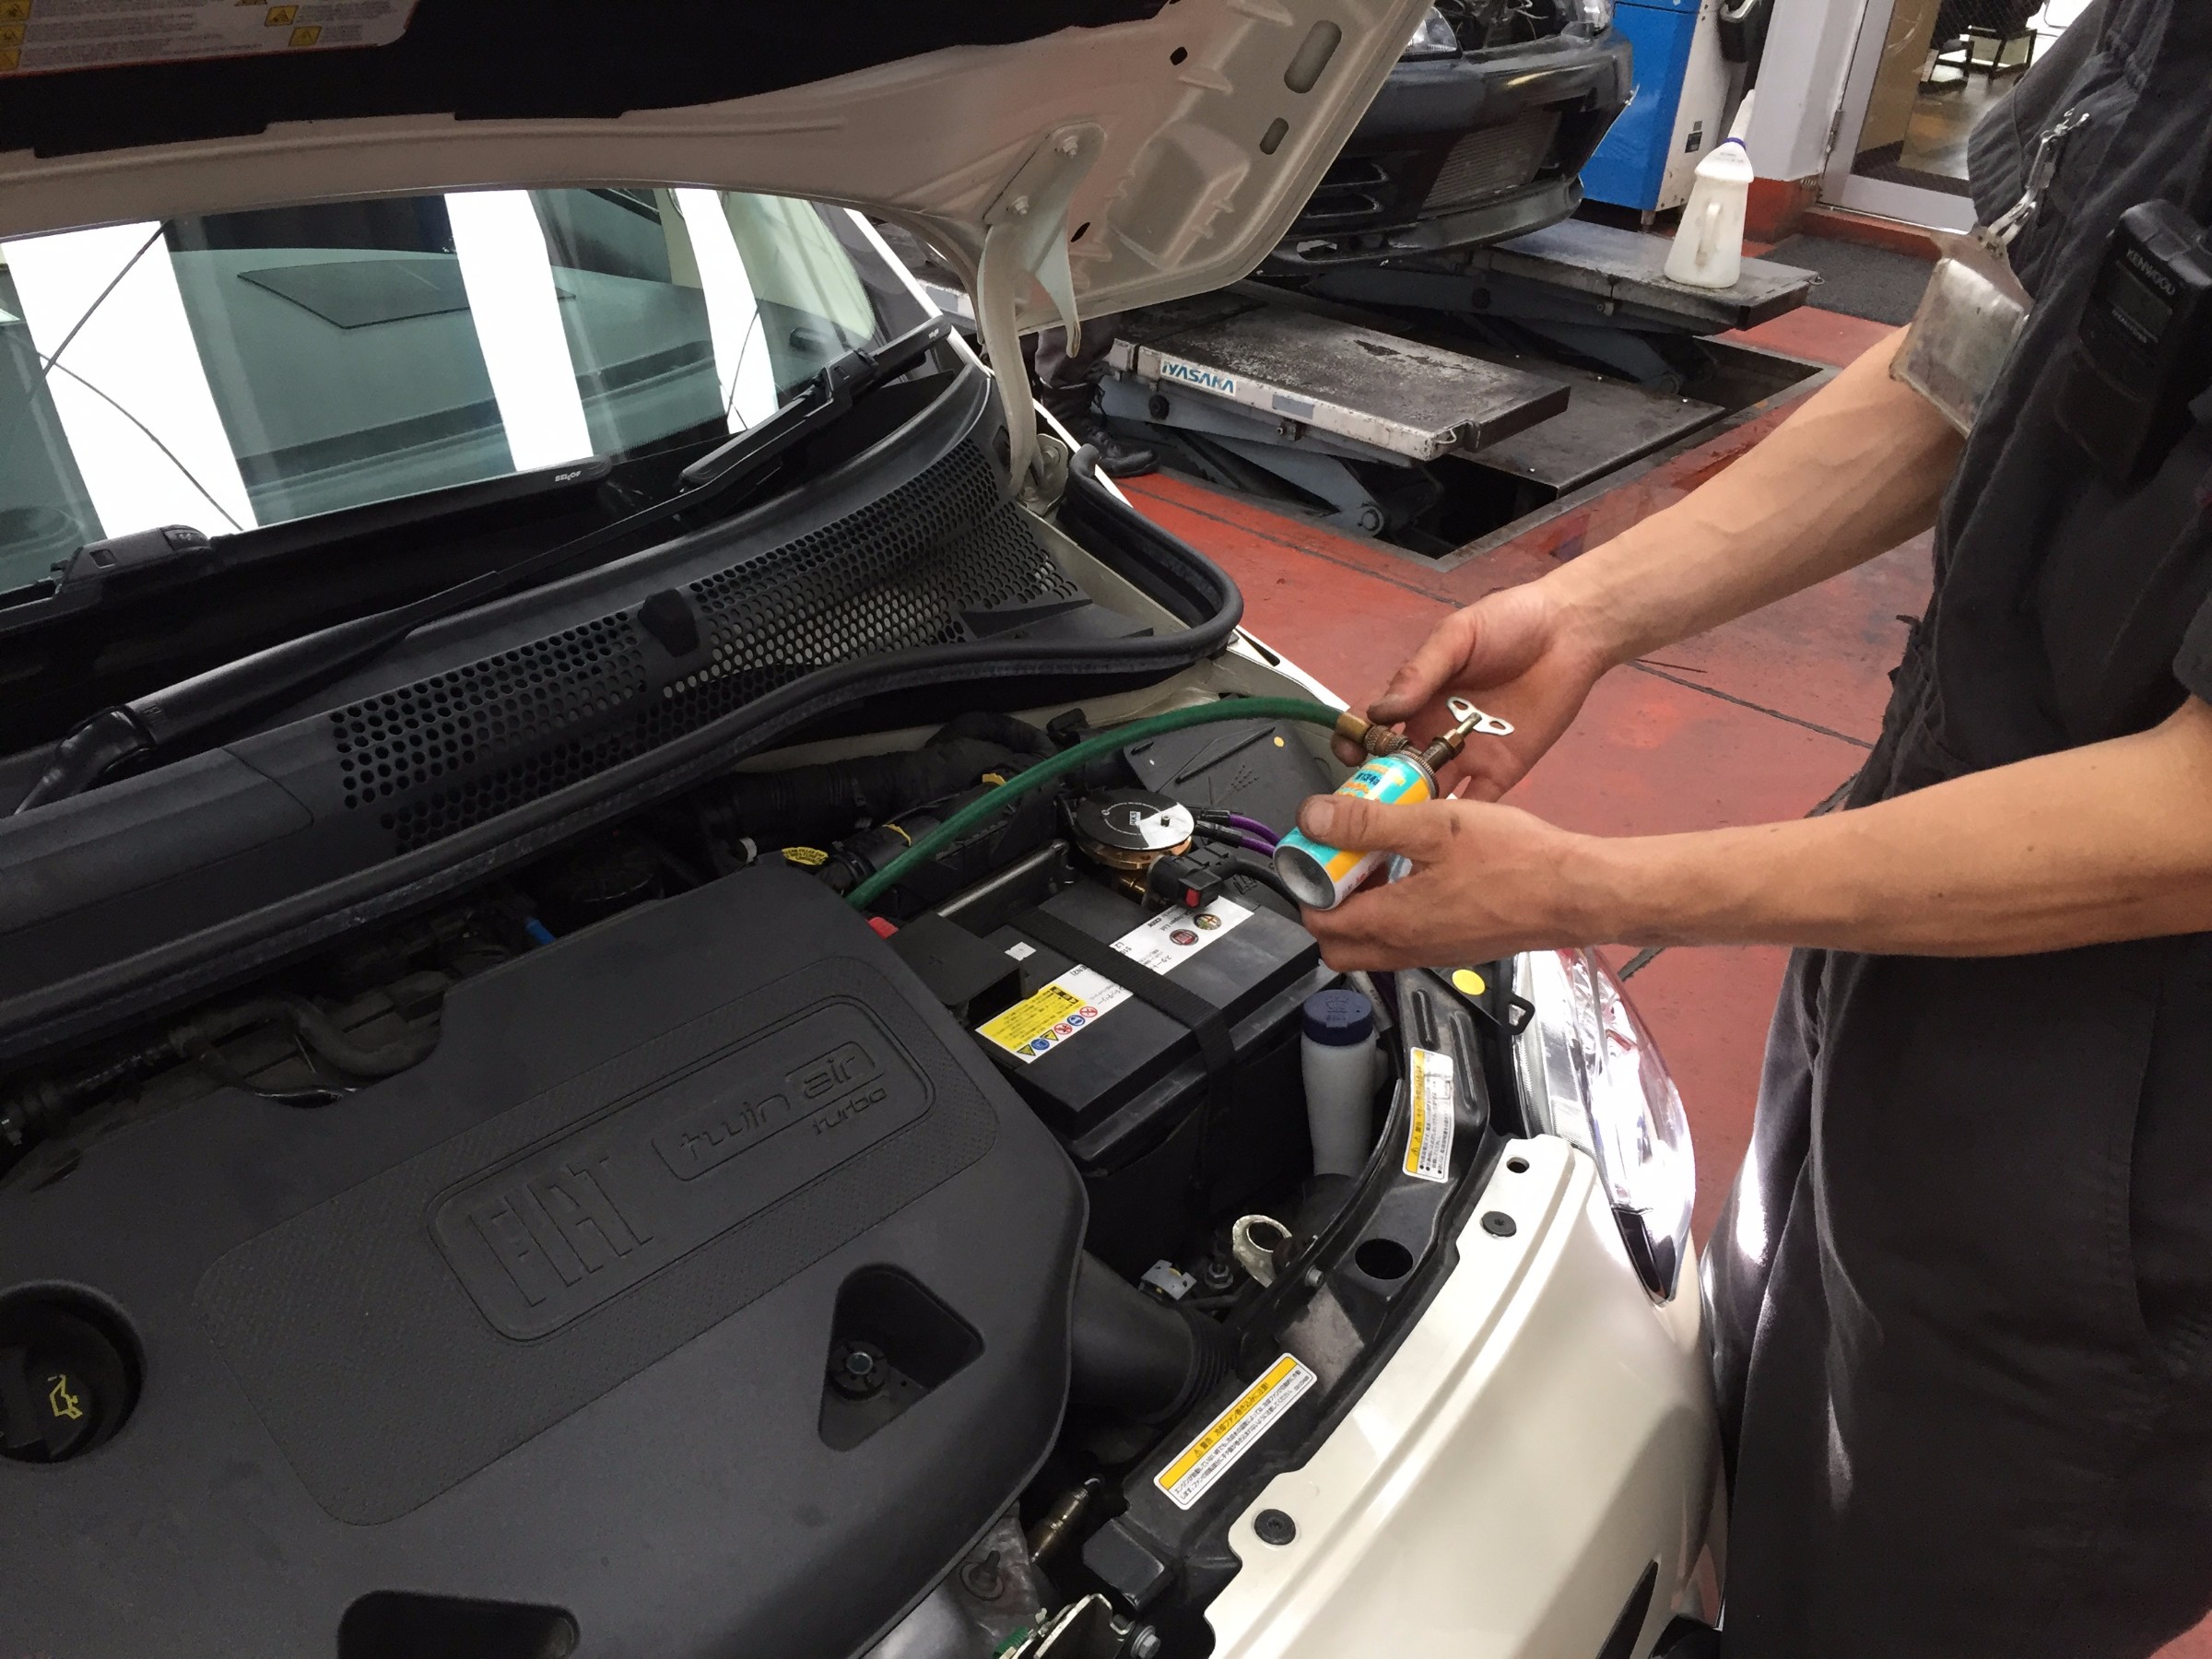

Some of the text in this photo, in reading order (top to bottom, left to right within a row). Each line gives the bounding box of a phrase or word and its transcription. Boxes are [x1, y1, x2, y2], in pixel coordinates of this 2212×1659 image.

[2125, 249, 2175, 295] KENWOOD
[1163, 363, 1234, 394] IYASAKA
[812, 1088, 888, 1135] turbo
[468, 1156, 653, 1307] FIAT
